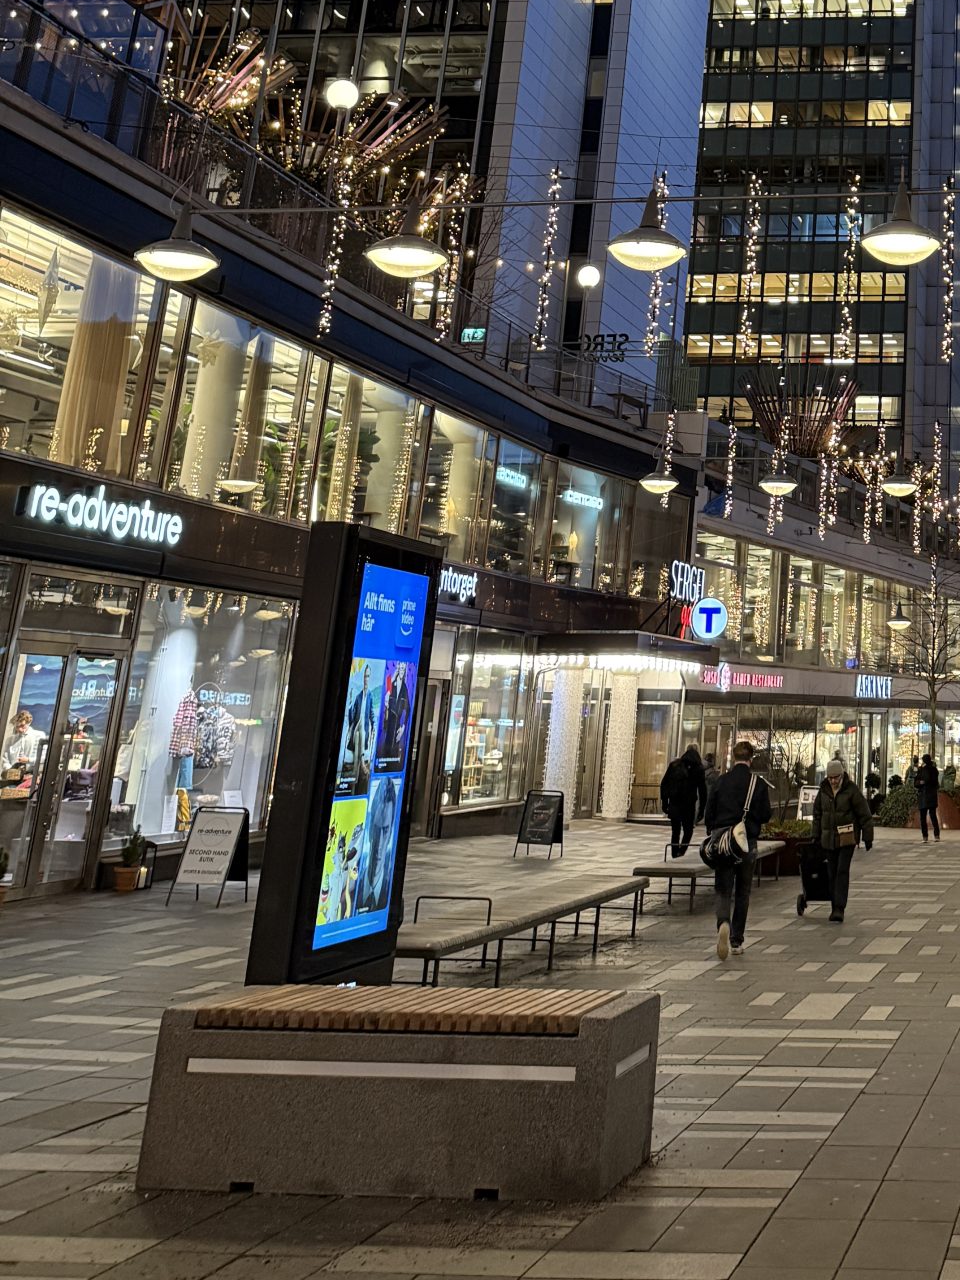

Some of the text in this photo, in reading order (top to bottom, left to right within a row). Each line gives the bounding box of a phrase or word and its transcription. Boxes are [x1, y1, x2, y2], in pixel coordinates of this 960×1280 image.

[30, 485, 182, 544] re-adventure
[402, 599, 417, 612] prime
[361, 612, 375, 632] här
[401, 613, 415, 626] video
[698, 607, 722, 634] T
[856, 674, 893, 699] ARKIVET
[188, 848, 230, 857] SECOND HAND
